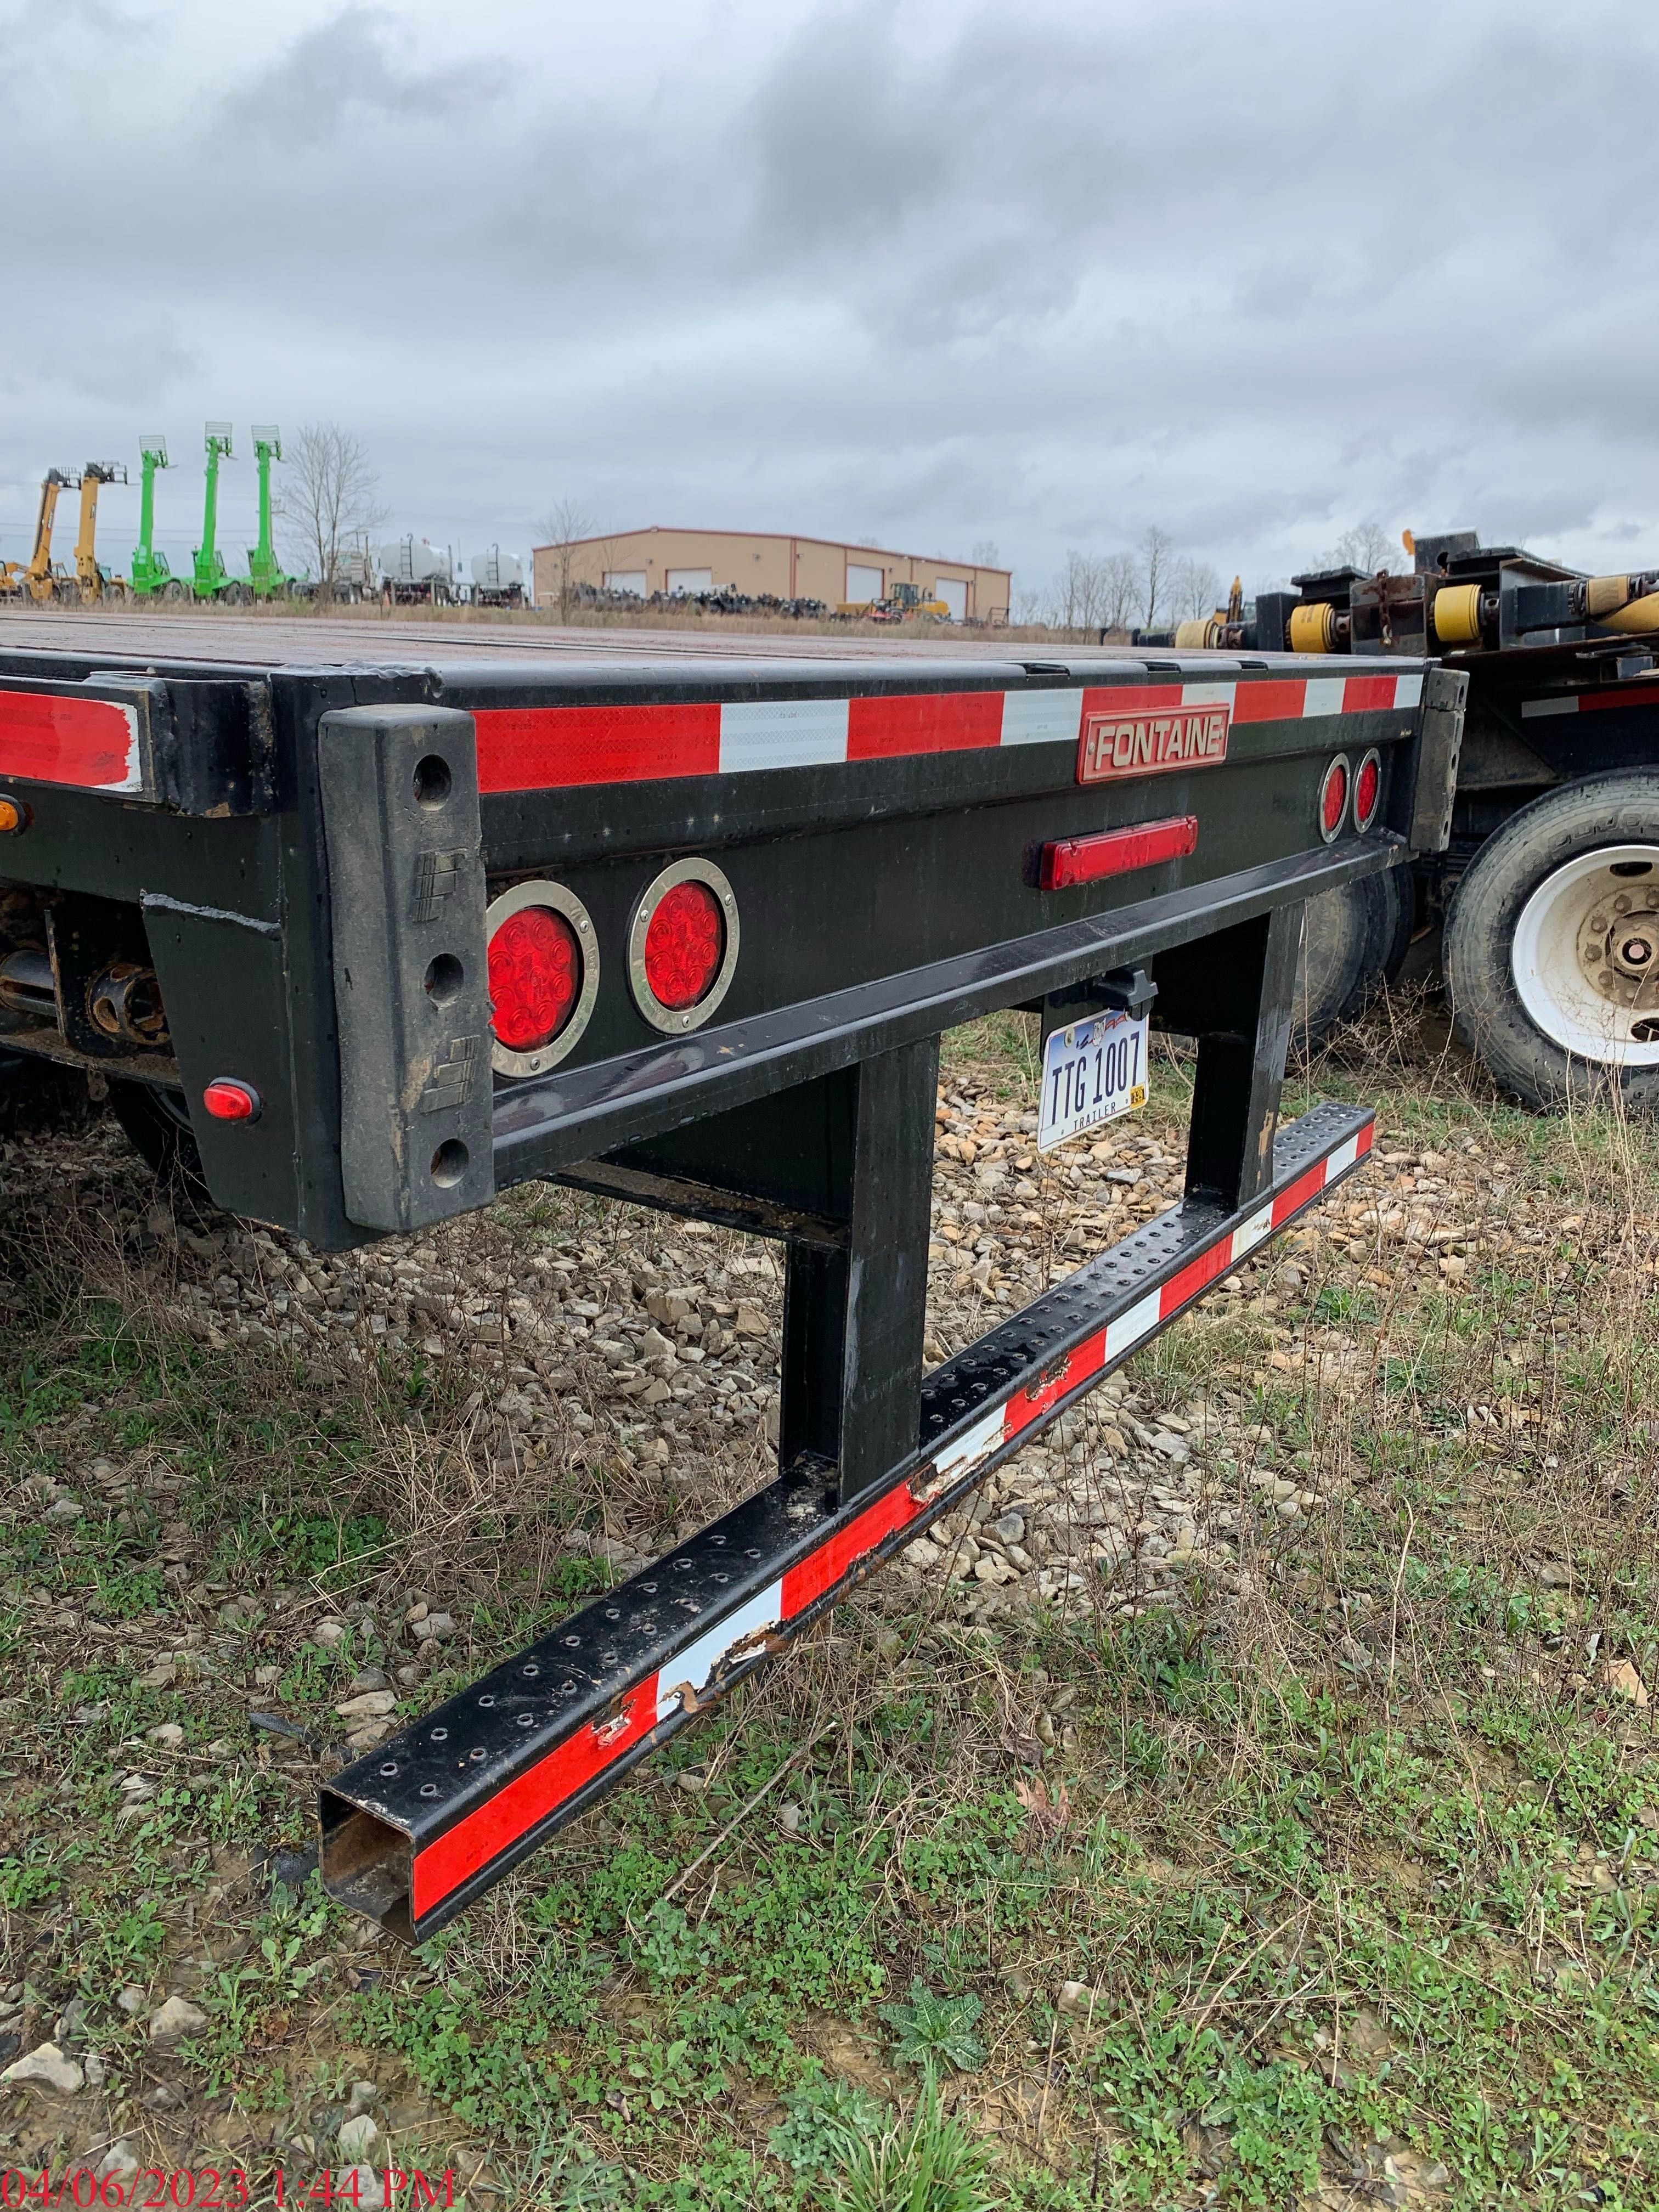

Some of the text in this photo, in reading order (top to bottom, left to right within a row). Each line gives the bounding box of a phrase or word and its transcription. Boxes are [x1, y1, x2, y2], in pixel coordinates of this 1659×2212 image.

[1095, 716, 1223, 769] FONTAINE
[1052, 1031, 1139, 1125] TTG 1007
[1074, 1102, 1116, 1129] TRAILER
